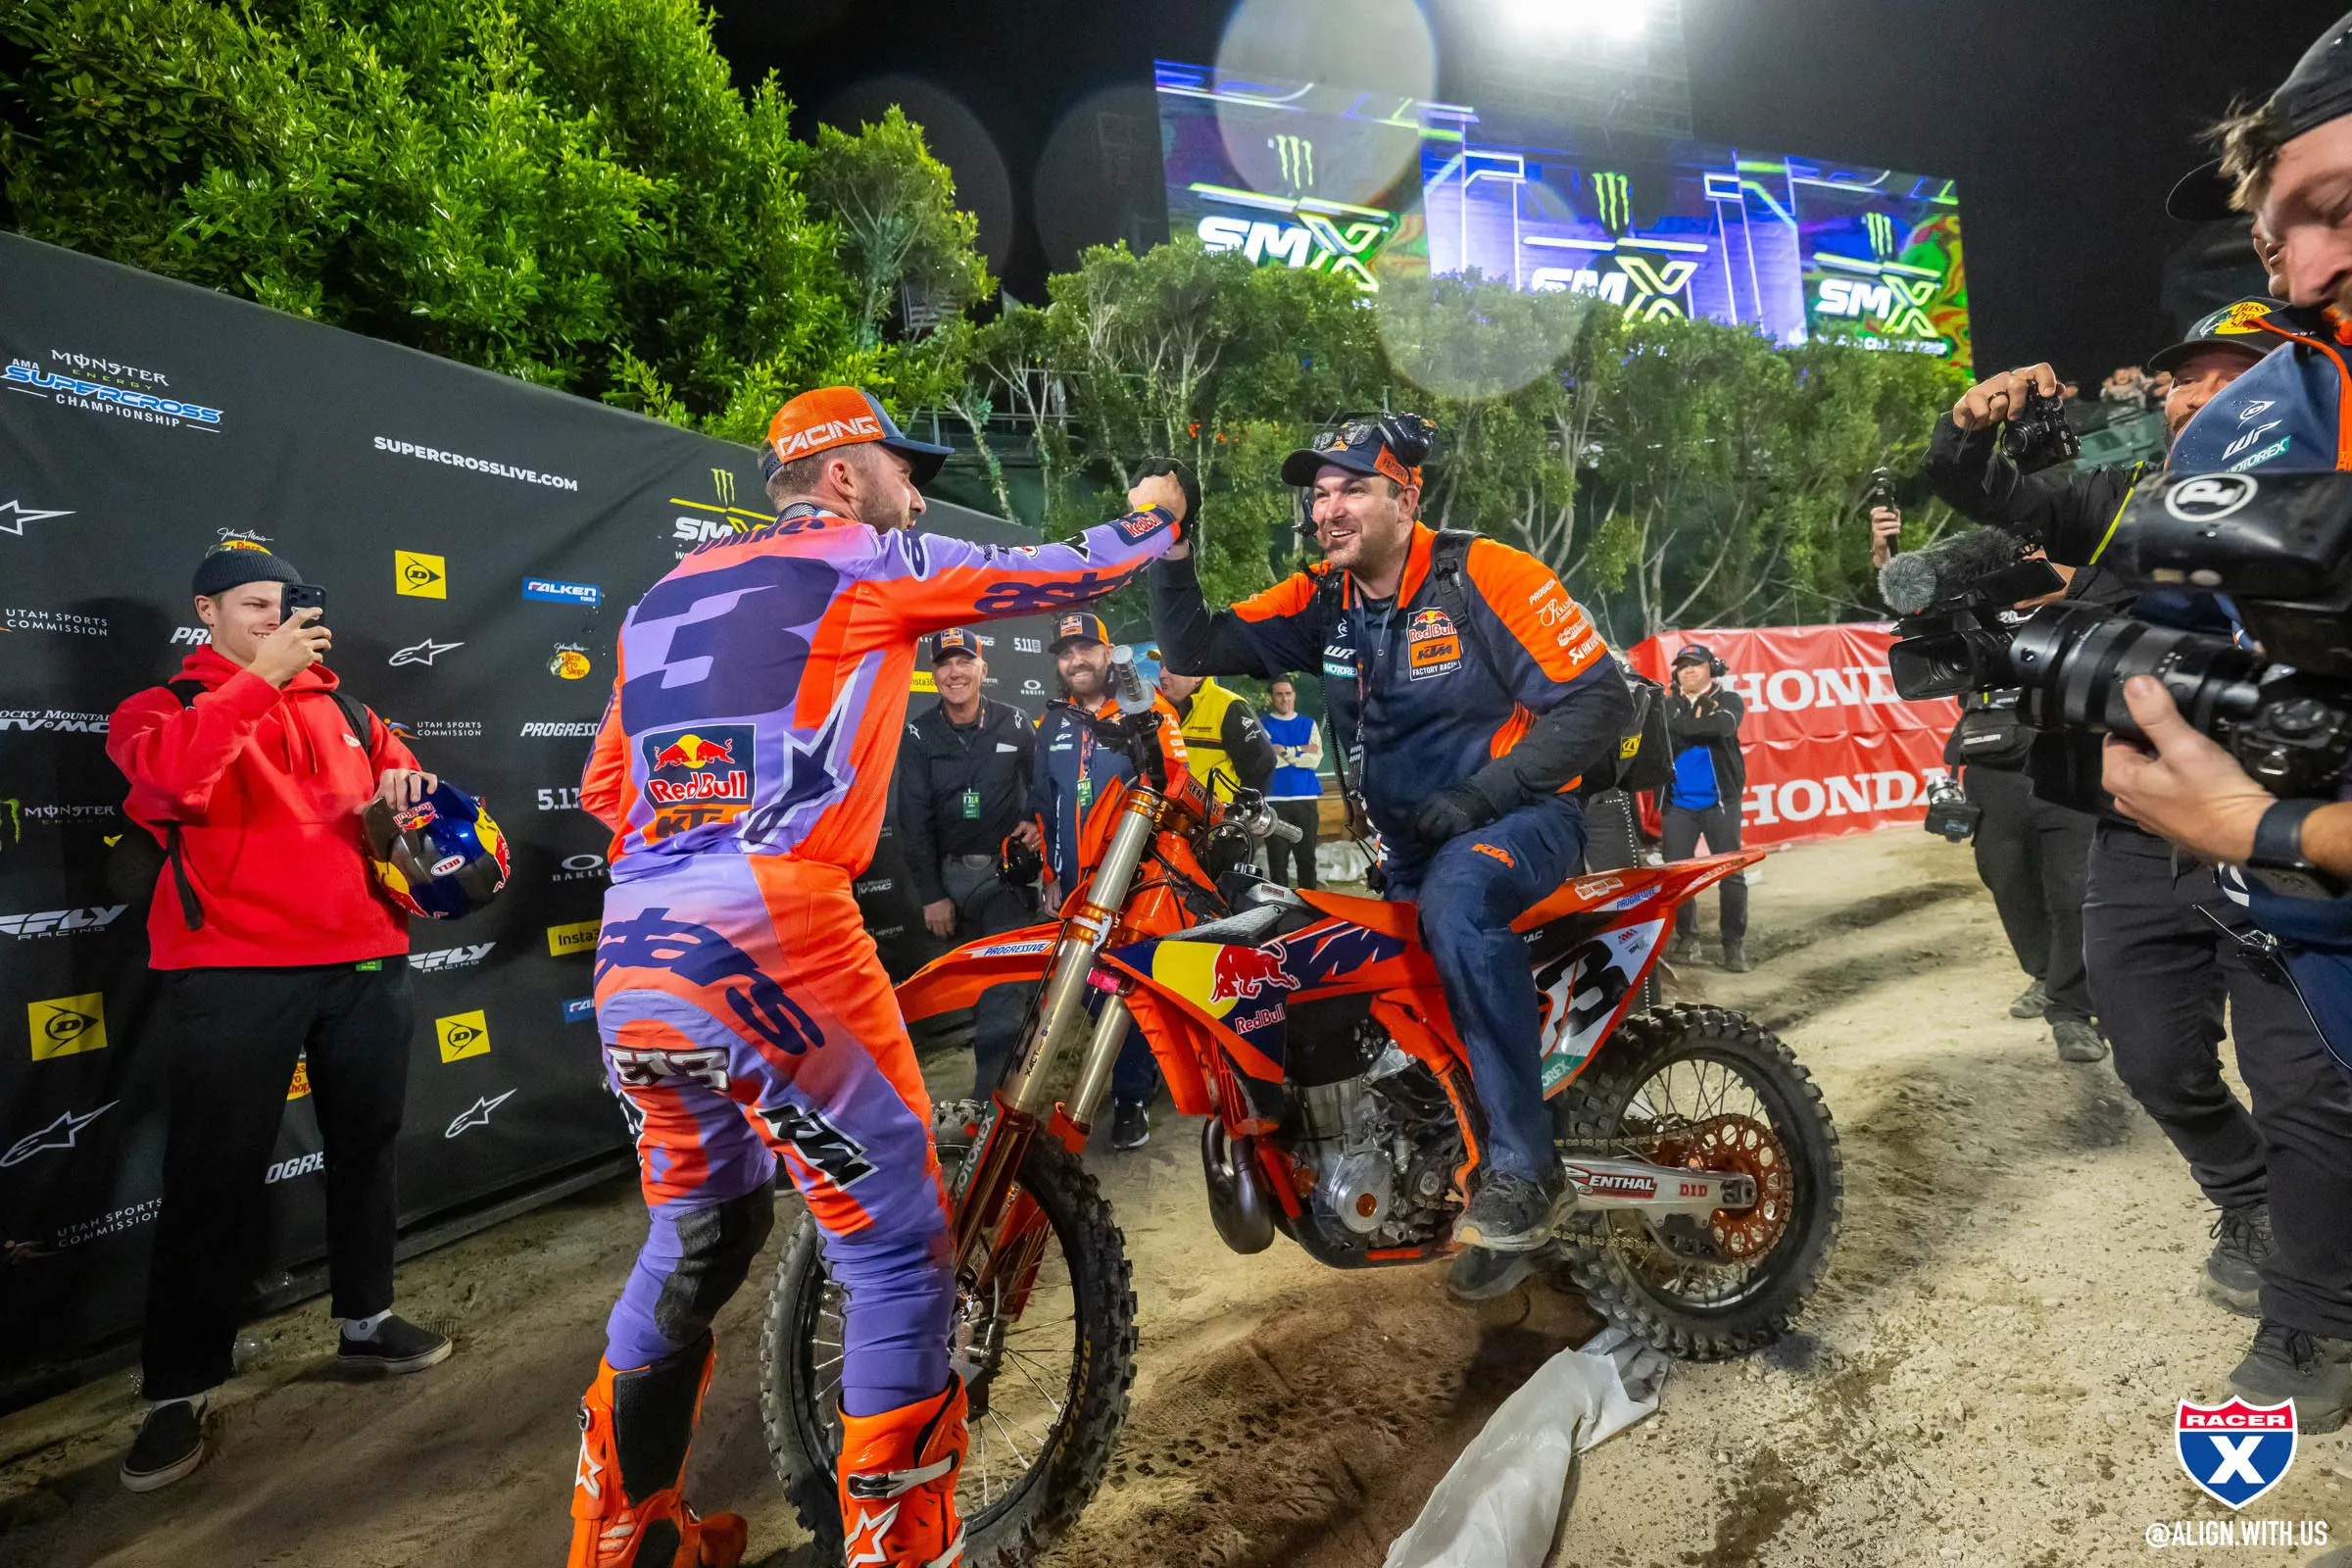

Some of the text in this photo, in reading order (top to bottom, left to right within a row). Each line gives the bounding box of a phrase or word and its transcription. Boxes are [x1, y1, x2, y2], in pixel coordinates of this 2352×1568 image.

[1815, 273, 1939, 337] SMX
[2235, 302, 2267, 315] Bass
[12, 358, 40, 370] AMA
[51, 349, 170, 386] MONSTER
[73, 368, 154, 391] ENERGY
[1, 365, 224, 423] SUPERCROSS
[56, 393, 180, 427] CHAMPIONSHIP
[777, 416, 879, 456] RACING
[373, 436, 578, 492] SUPERCROSSLIVE.COM
[528, 581, 597, 597] FALKEN
[6, 609, 109, 627] UTAH SPORTS
[7, 618, 109, 636] COMMISSION
[621, 556, 840, 735] 3
[1412, 664, 1439, 677] FACTORY
[24, 805, 116, 818] MONSTER
[436, 858, 461, 873] BELL
[18, 926, 105, 941] RACING
[984, 941, 1047, 956] PROGRESSIVE
[422, 960, 480, 973] RACING
[1679, 1183, 1708, 1198] DID
[58, 1198, 162, 1237] UTAH SPORTS
